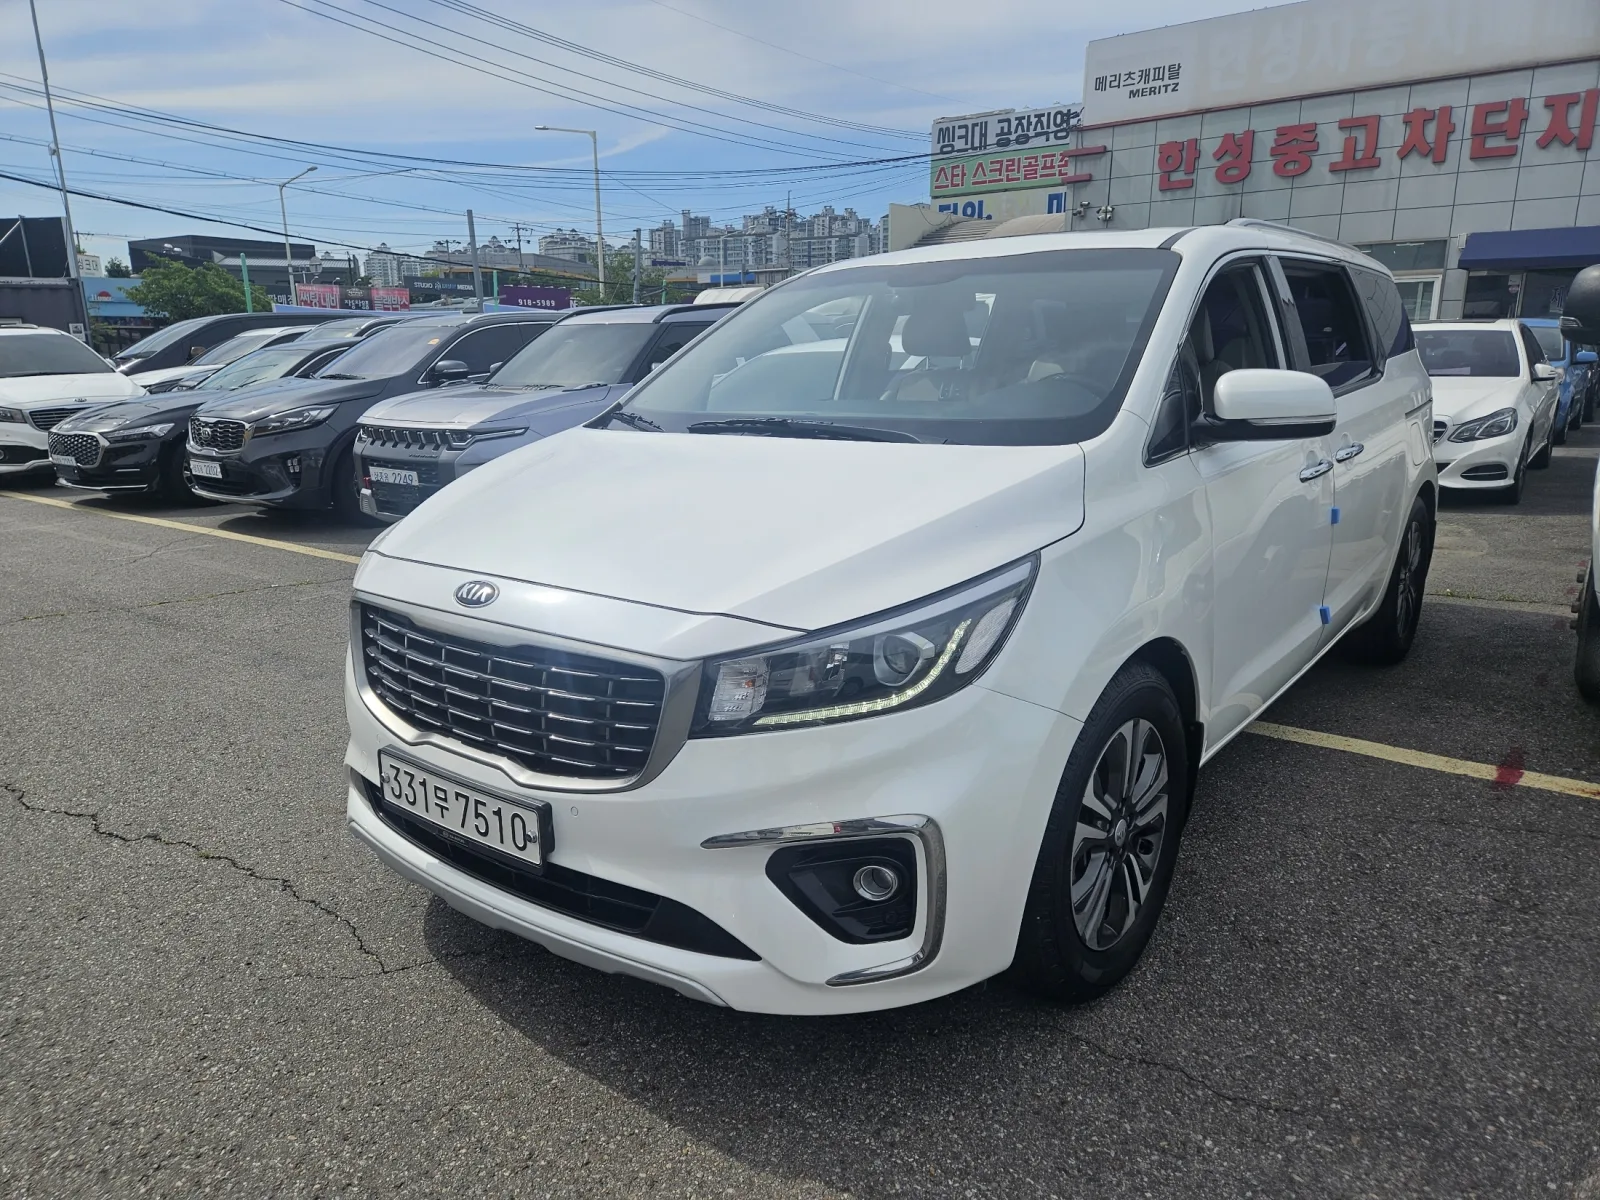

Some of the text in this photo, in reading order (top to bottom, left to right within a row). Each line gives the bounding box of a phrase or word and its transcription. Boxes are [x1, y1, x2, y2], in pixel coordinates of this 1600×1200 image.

[1094, 62, 1182, 92] 메리츠캐피탈
[1128, 81, 1180, 99] MERITZ
[936, 108, 1071, 155] 씽크대 공장직영
[1157, 89, 1600, 191] 한성중고차단지
[934, 164, 967, 190] 스타
[413, 281, 433, 289] STUDIO
[456, 582, 494, 604] KIA
